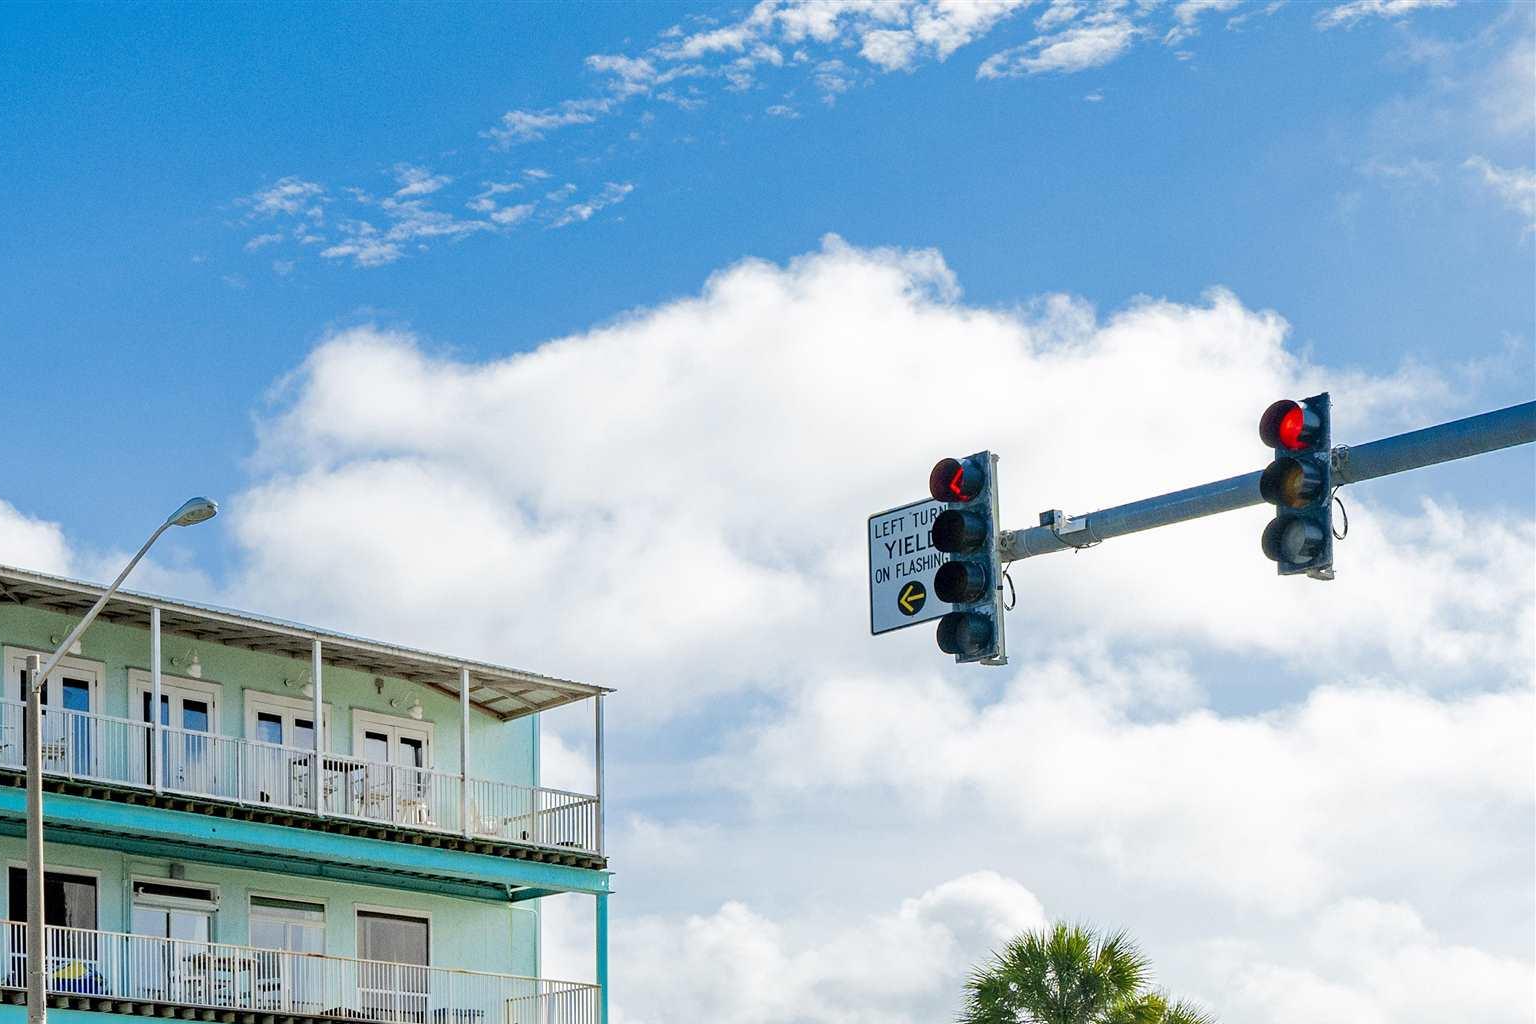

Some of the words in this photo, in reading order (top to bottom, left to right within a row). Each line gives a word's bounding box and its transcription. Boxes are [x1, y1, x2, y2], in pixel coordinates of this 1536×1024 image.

[875, 517, 904, 539] LEFT
[875, 567, 890, 584] ON
[896, 553, 950, 579] FLASHING
